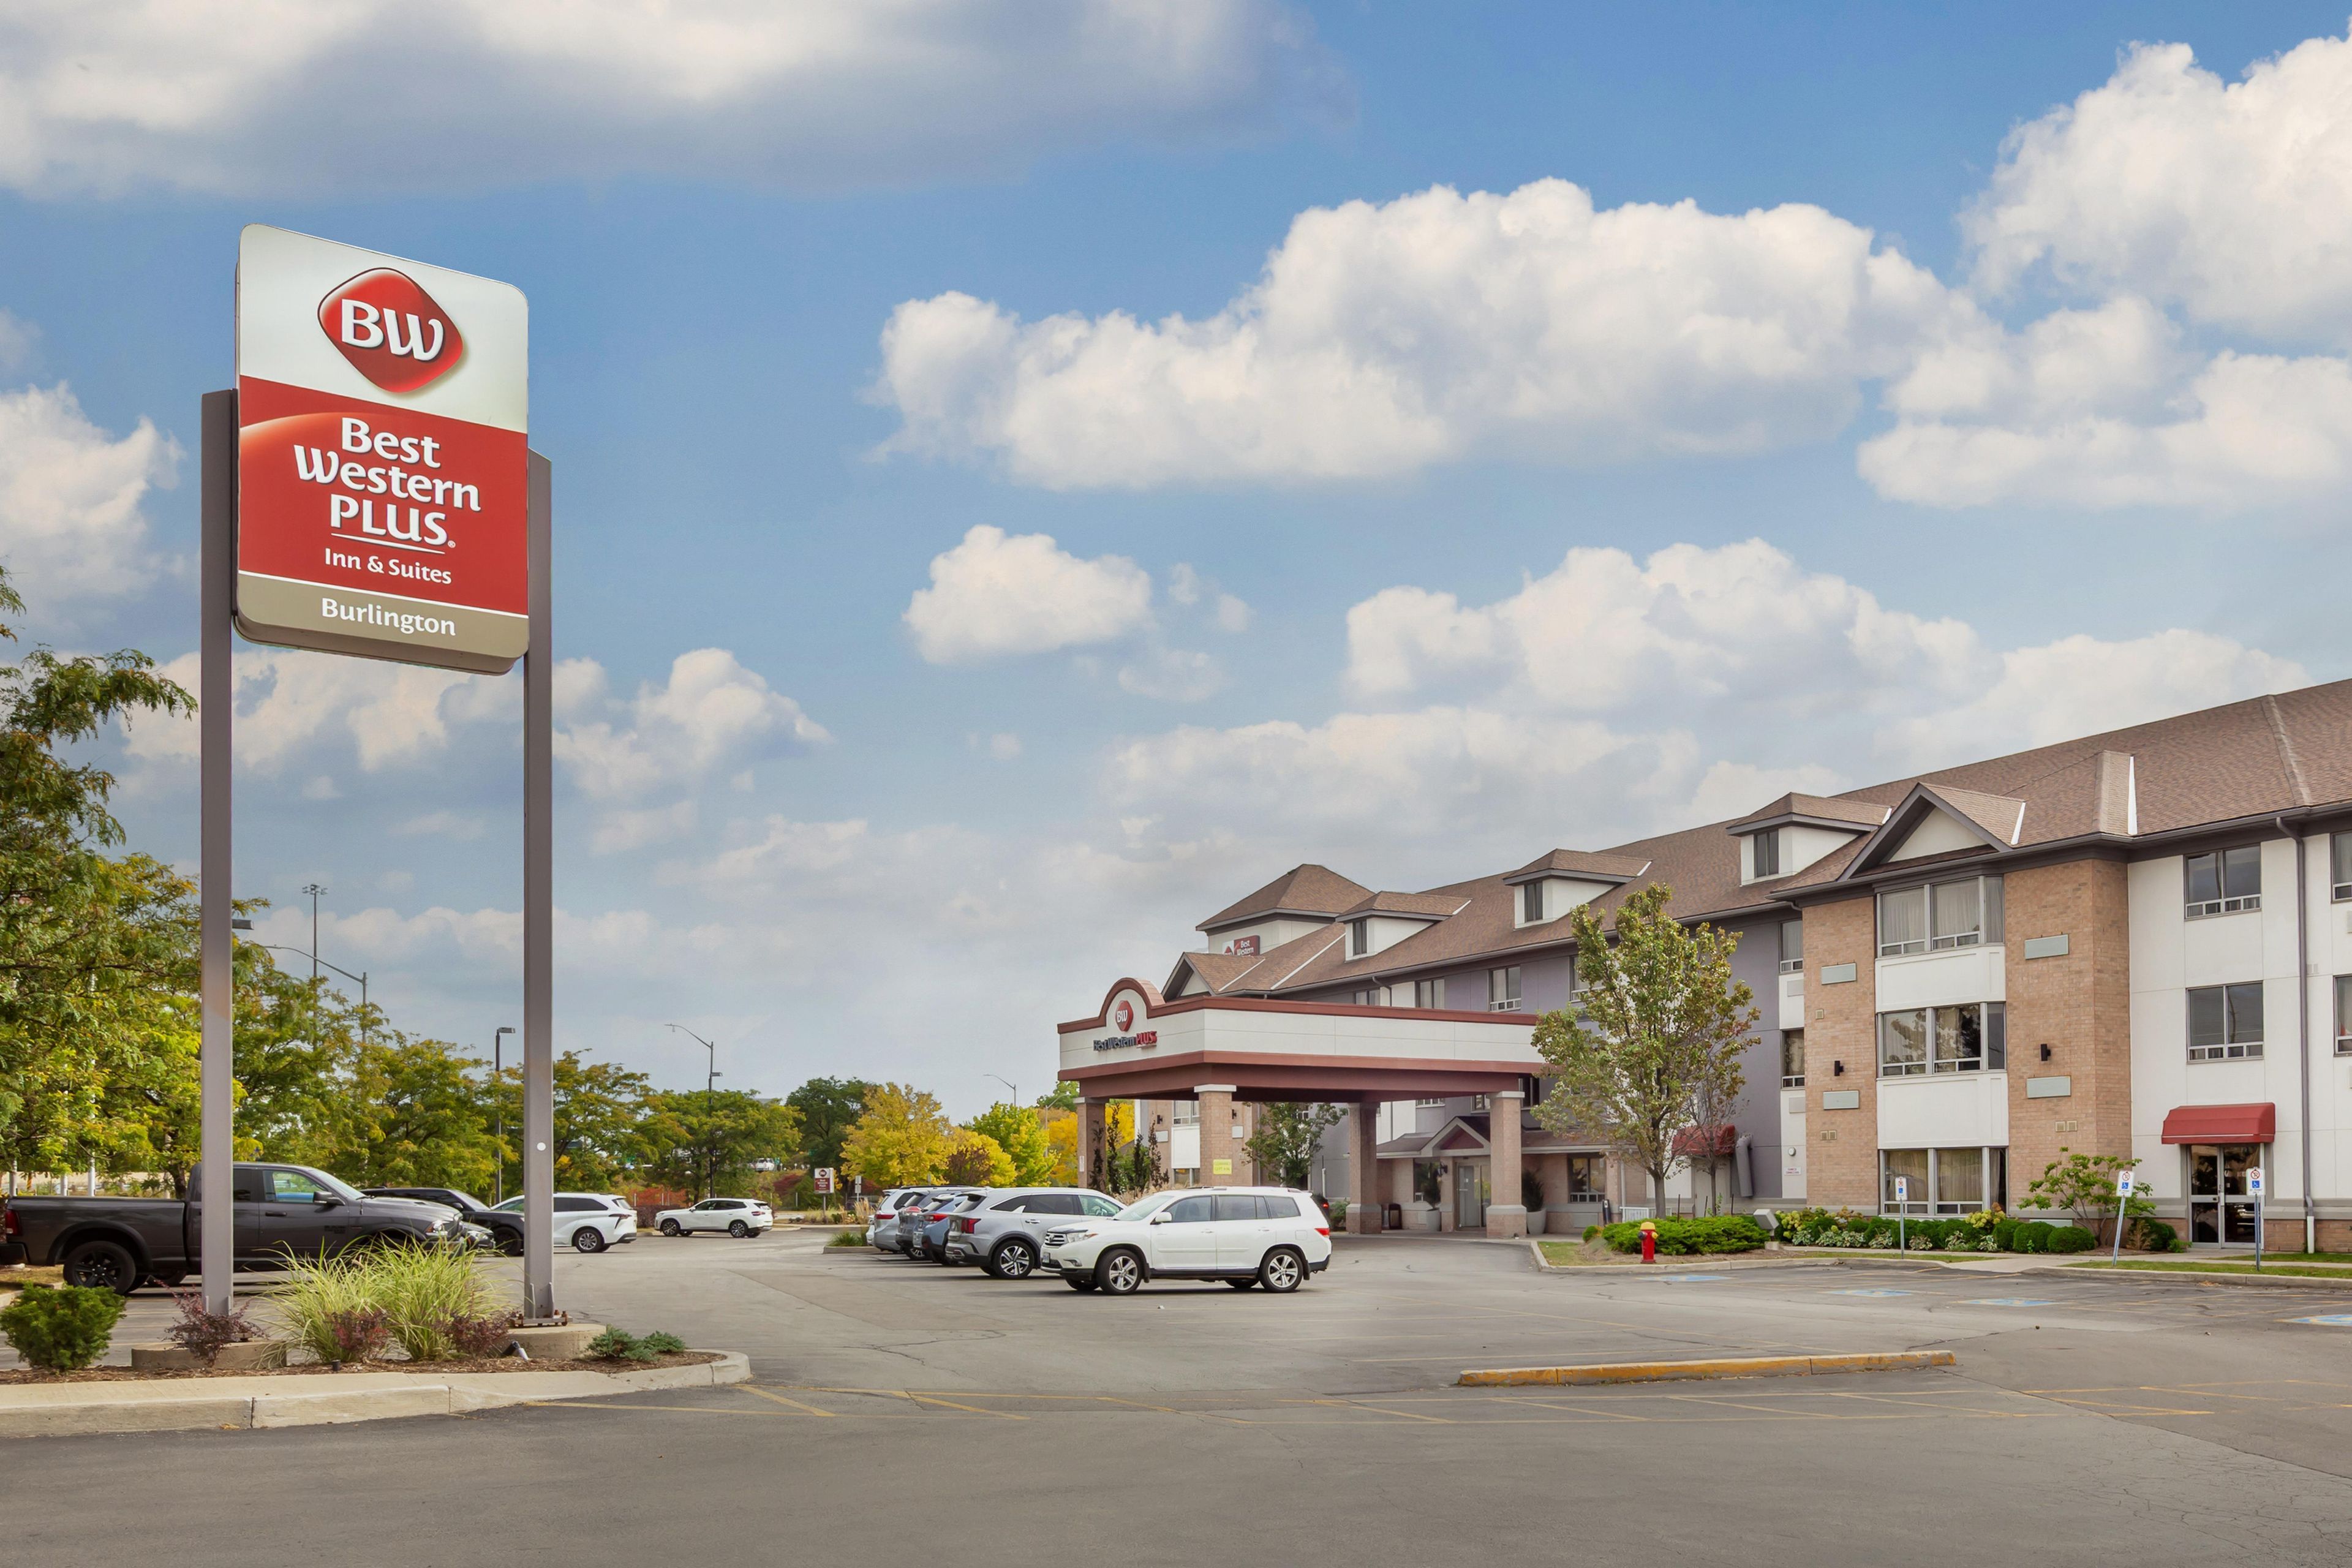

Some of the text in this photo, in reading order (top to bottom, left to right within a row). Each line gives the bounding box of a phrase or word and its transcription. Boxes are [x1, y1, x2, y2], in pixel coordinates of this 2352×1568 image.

[341, 298, 445, 361] BW
[341, 417, 442, 468] Best
[293, 445, 481, 512] Western
[325, 548, 452, 584] Inn & Suites
[322, 598, 456, 636] Burlington
[1117, 1009, 1128, 1023] BW
[1093, 1031, 1157, 1051] Best Western PLUS
